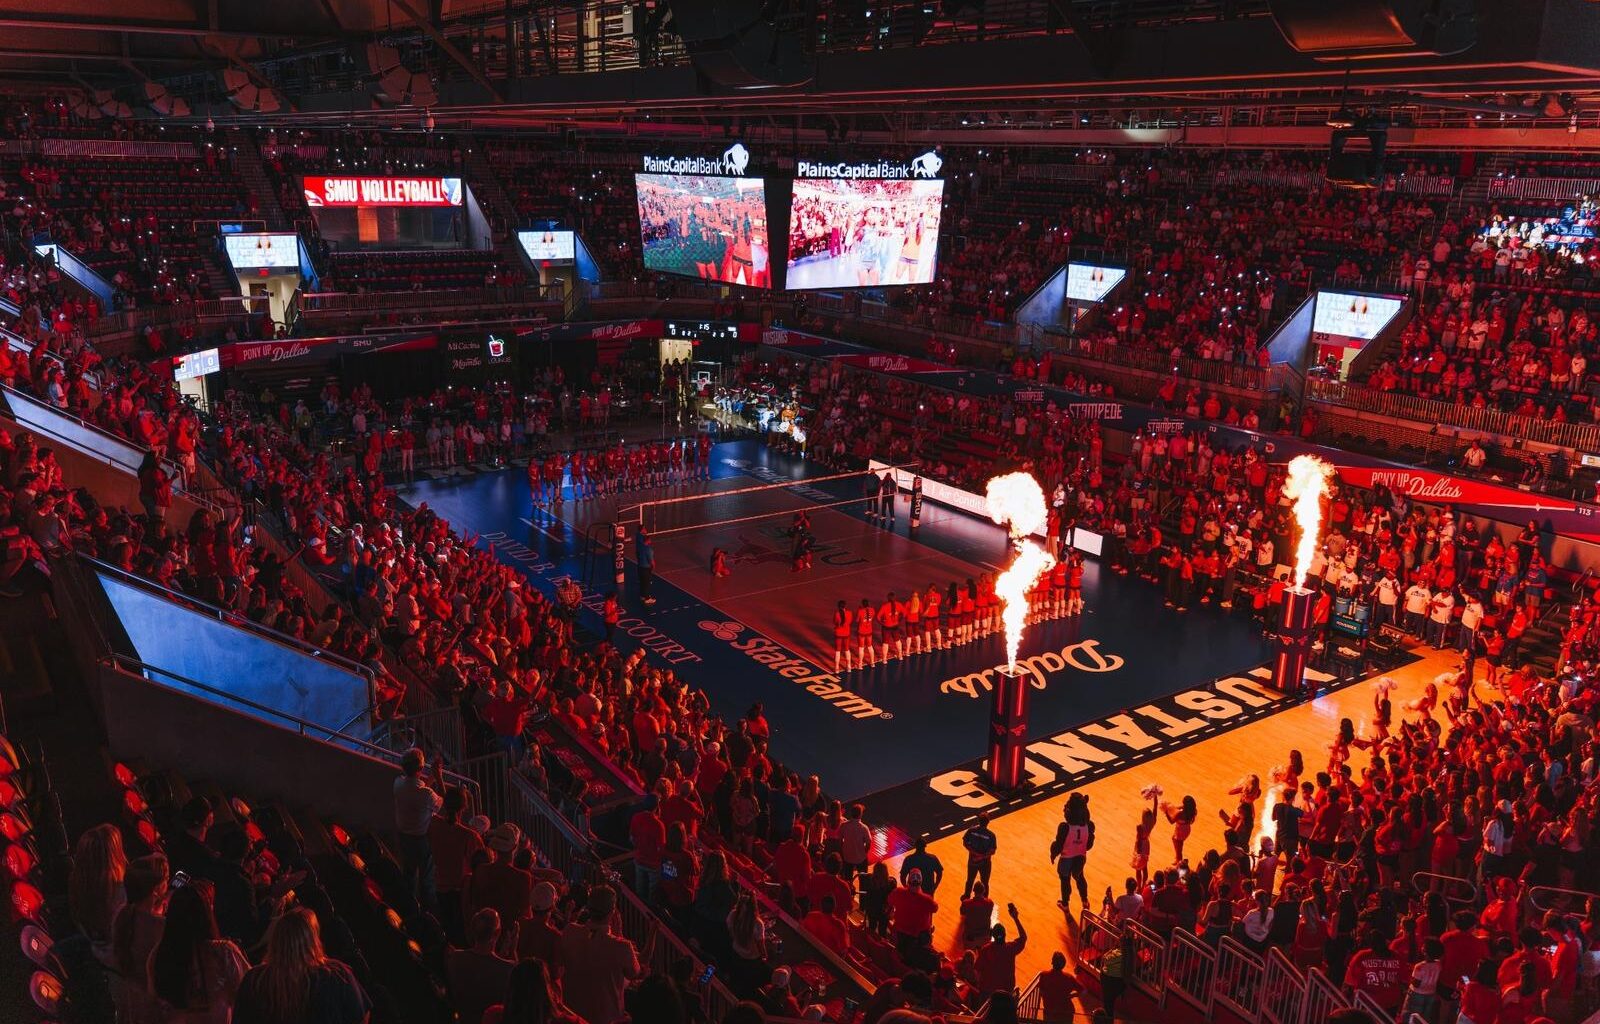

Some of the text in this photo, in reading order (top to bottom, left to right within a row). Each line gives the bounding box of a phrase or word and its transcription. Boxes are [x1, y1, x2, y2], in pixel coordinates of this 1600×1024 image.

[324, 179, 445, 203] SMU VOLLEYBALL
[612, 321, 641, 339] Dallas
[1316, 333, 1330, 341] 212
[353, 339, 372, 347] SMU
[243, 344, 311, 362] PONY UP Dallas
[1014, 391, 1044, 402] STAMPEDE
[1068, 402, 1123, 420] STAMPEDE
[1146, 420, 1185, 433] STAMPEDE
[1371, 471, 1463, 498] PONY UP Dallas
[914, 491, 923, 515] SMU
[1578, 507, 1592, 516] 113
[615, 542, 625, 569] SMU
[480, 531, 540, 562] DAVID
[616, 618, 703, 665] COURT
